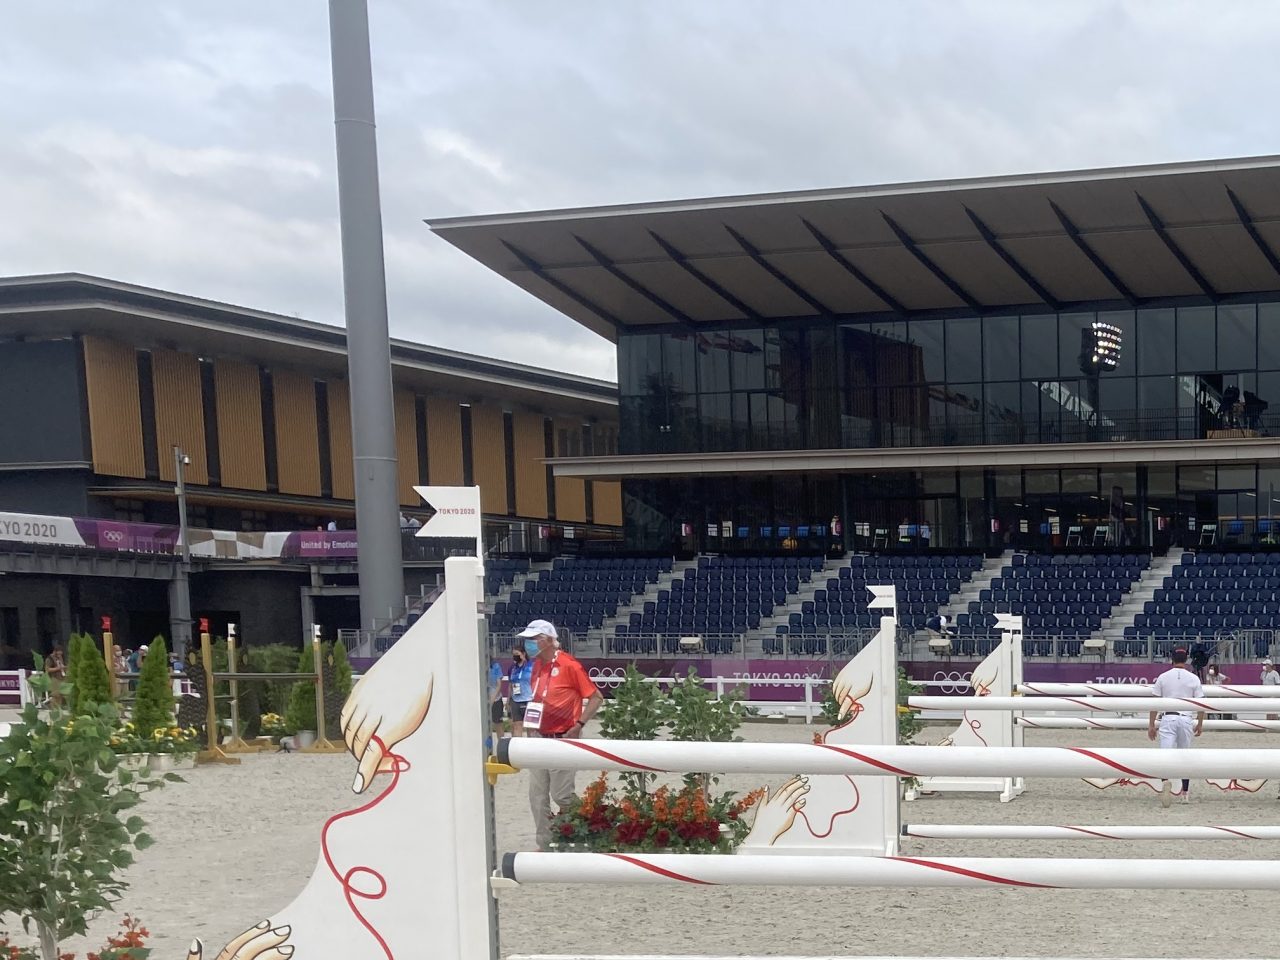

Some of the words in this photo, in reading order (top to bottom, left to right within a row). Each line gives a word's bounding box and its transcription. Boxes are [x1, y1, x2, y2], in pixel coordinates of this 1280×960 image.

[24, 522, 57, 538] 2020
[301, 540, 321, 549] United
[324, 540, 331, 550] by
[733, 672, 780, 687] TOKYO
